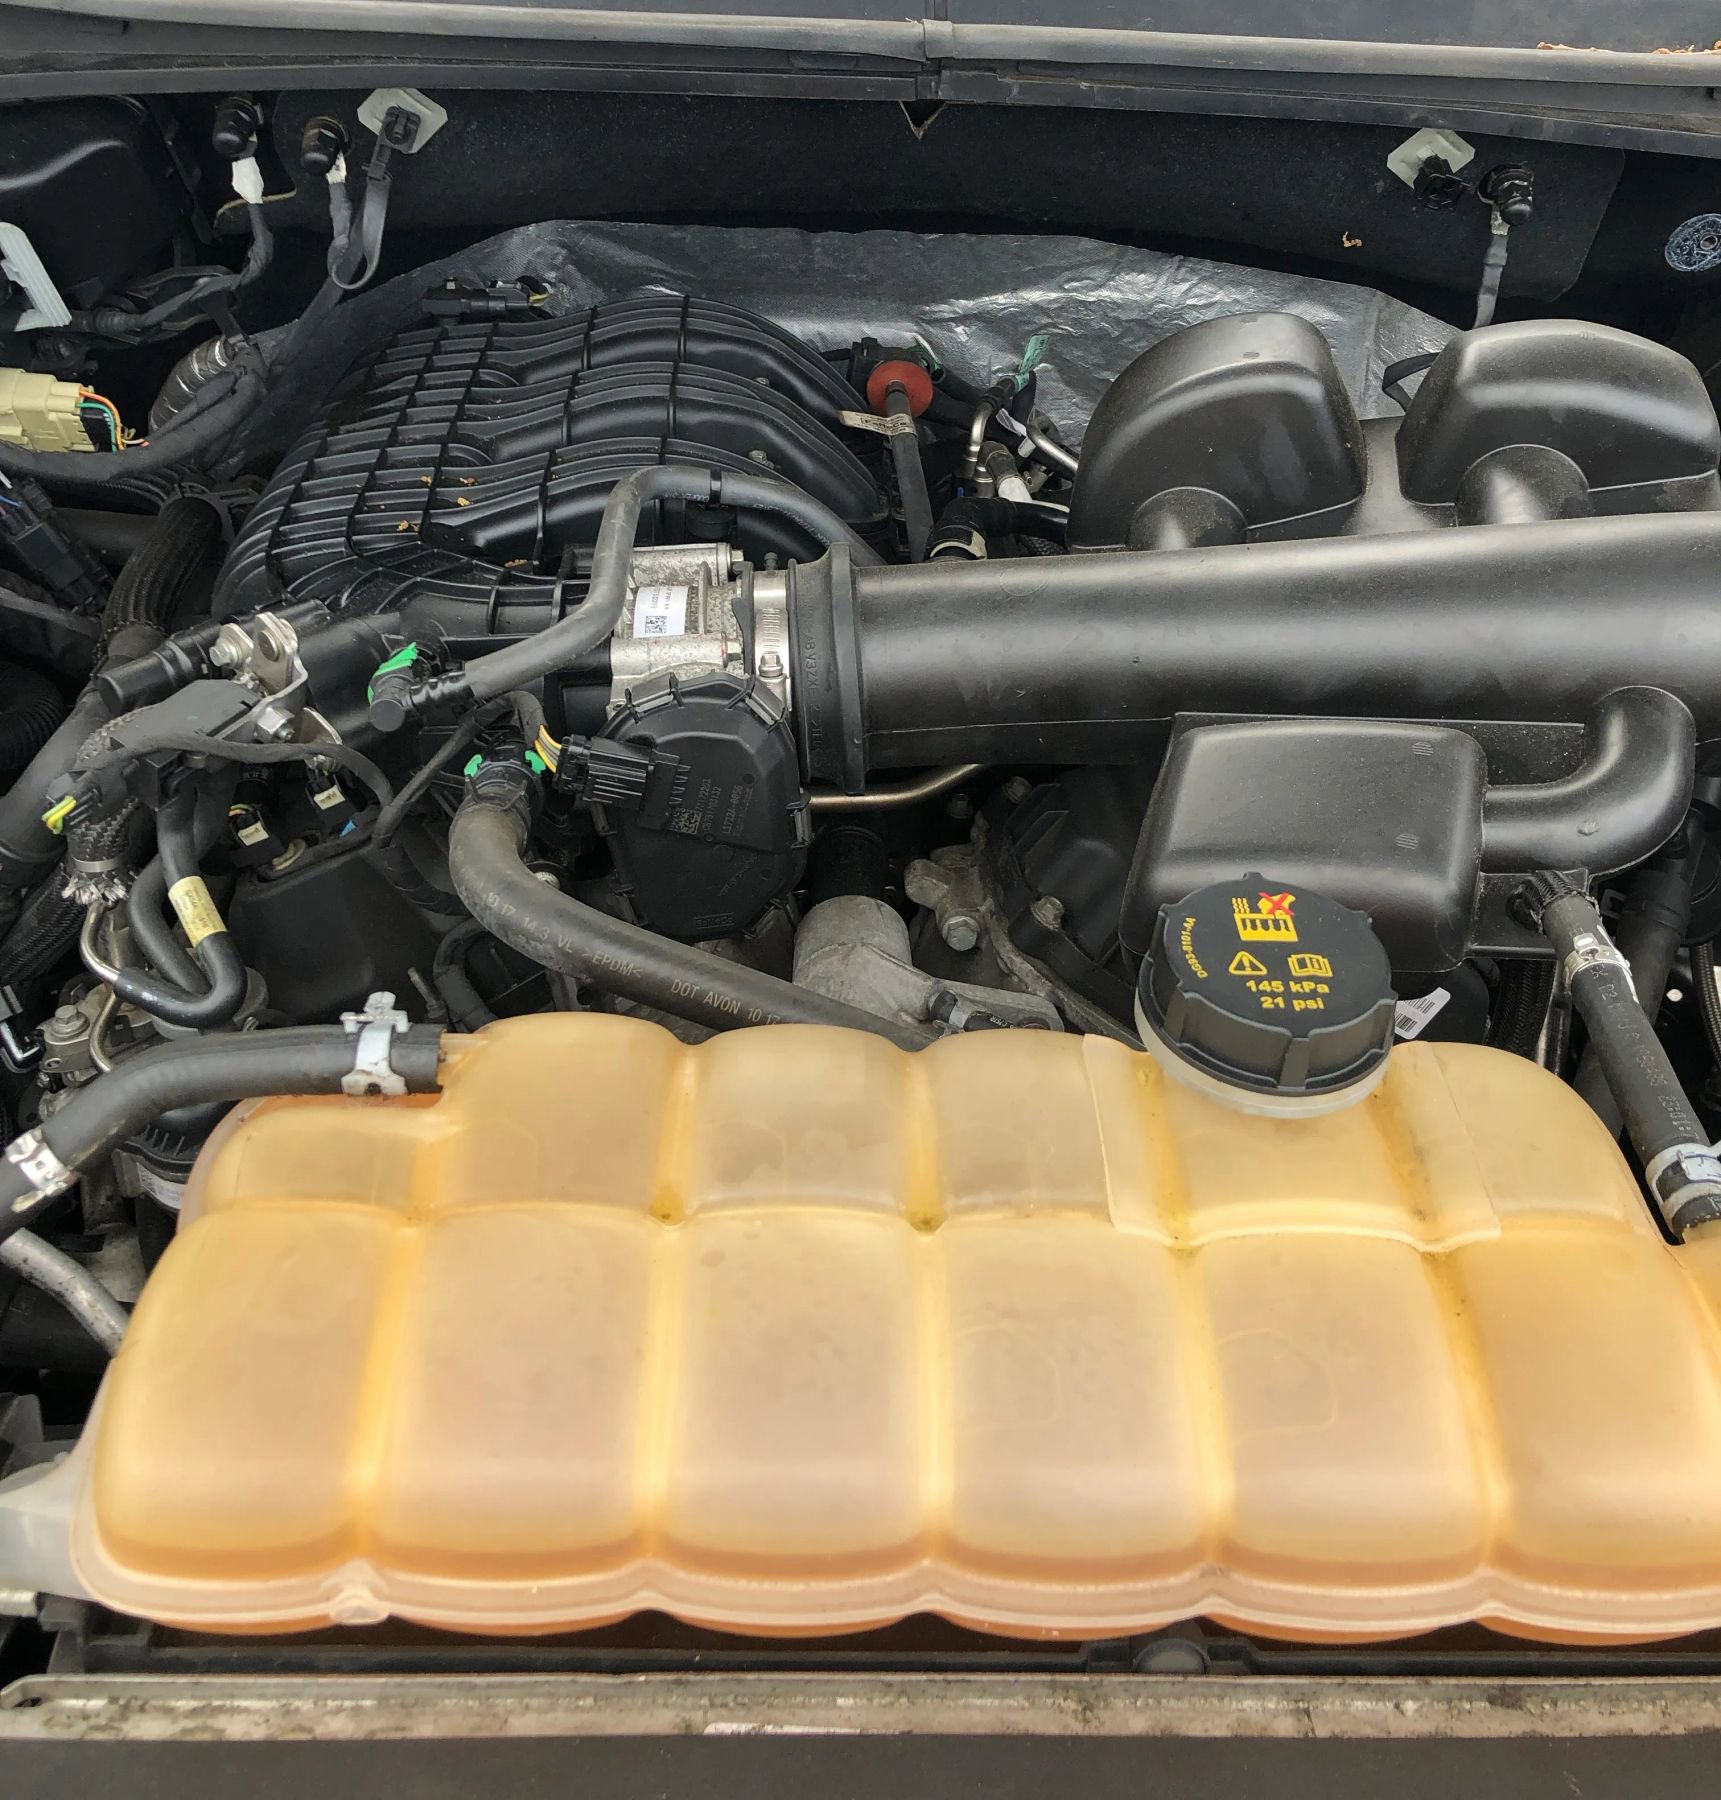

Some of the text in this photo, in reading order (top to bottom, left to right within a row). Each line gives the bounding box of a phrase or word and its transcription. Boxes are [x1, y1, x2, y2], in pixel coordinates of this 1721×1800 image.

[582, 948, 643, 979] >EPDM<
[671, 978, 699, 999] DOT
[703, 991, 741, 1015] AVON
[747, 1006, 763, 1023] 10
[1246, 980, 1329, 993] 145 kPa
[1260, 996, 1324, 1011] 21 psi
